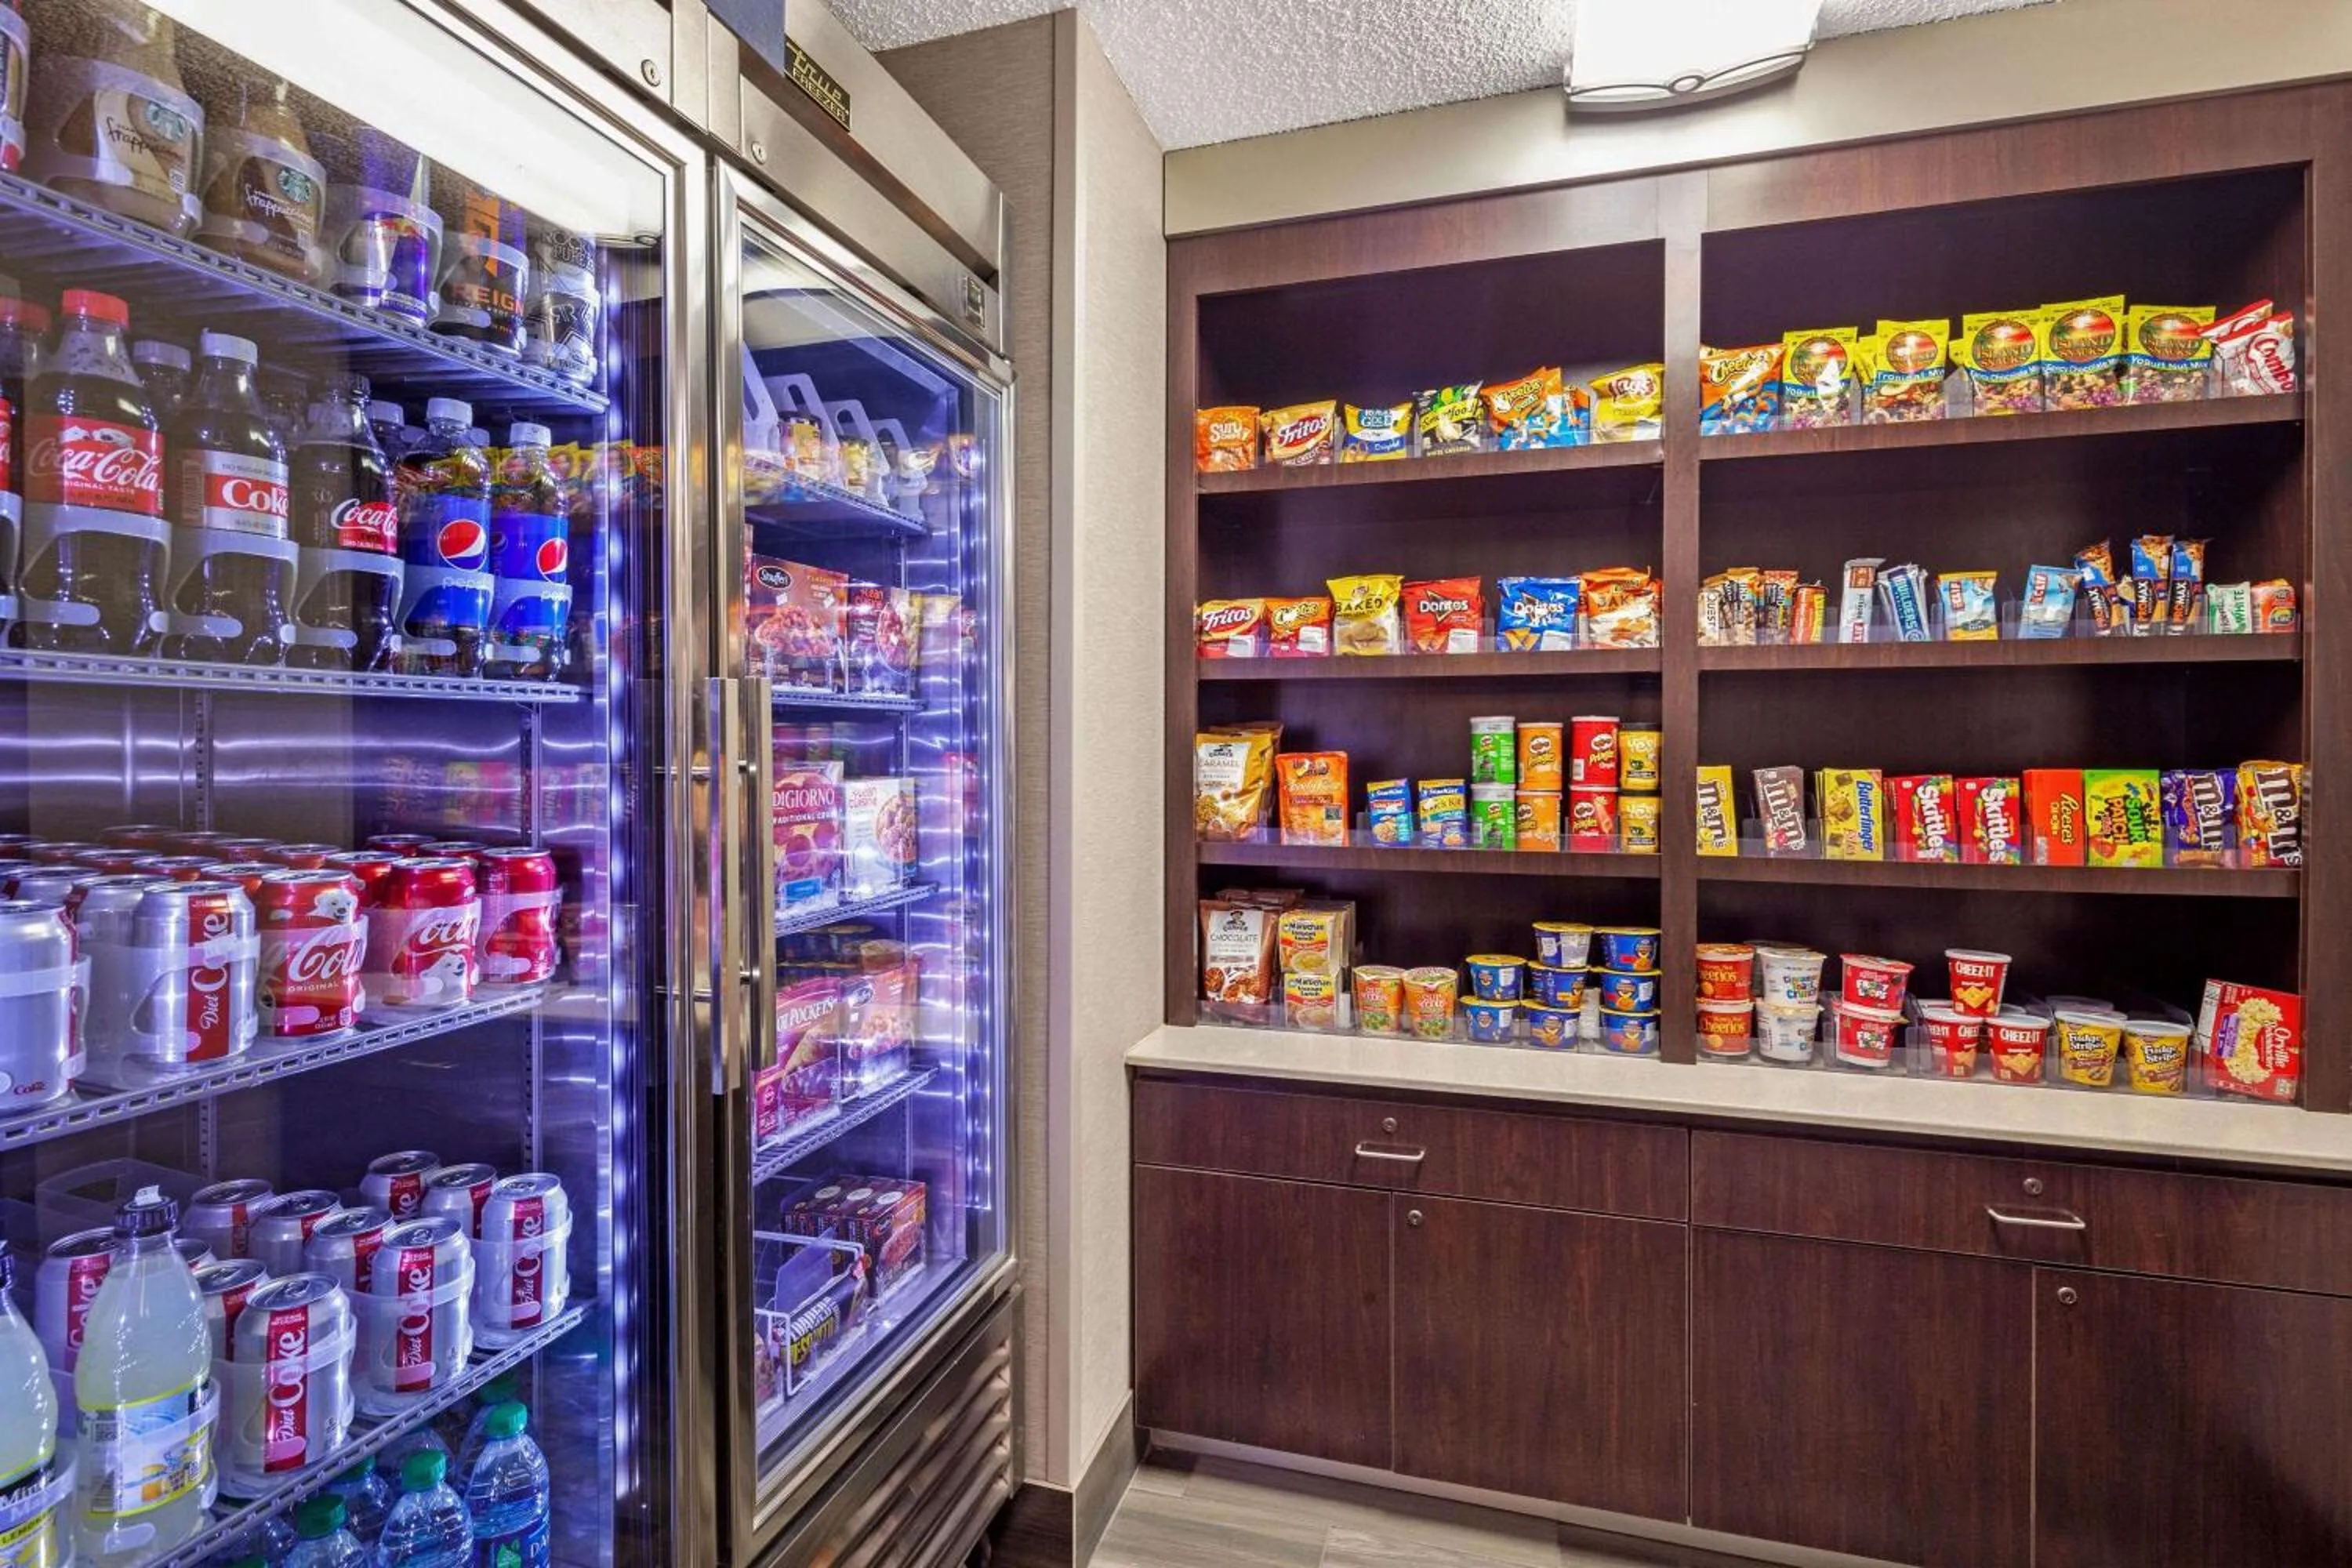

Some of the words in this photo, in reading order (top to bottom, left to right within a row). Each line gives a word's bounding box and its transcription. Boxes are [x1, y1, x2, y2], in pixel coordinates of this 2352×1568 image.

[2131, 356, 2167, 368] Yogurt
[2255, 337, 2296, 393] Combo
[1277, 416, 1330, 448] Fritos
[1201, 607, 1253, 630] Fritos
[1418, 599, 1469, 613] Doritos
[1856, 780, 1875, 853] Butterfinger
[1916, 785, 1947, 859] Skittles
[1980, 786, 2013, 864] Skittles
[2060, 793, 2080, 845] Reese's
[2125, 797, 2144, 842] SOUR
[1210, 934, 1258, 942] CHOCOLATE
[1955, 961, 1995, 978] CHEEZ-IT
[2000, 1028, 2041, 1043] CHEEZ-IT
[268, 1329, 307, 1408] Coke
